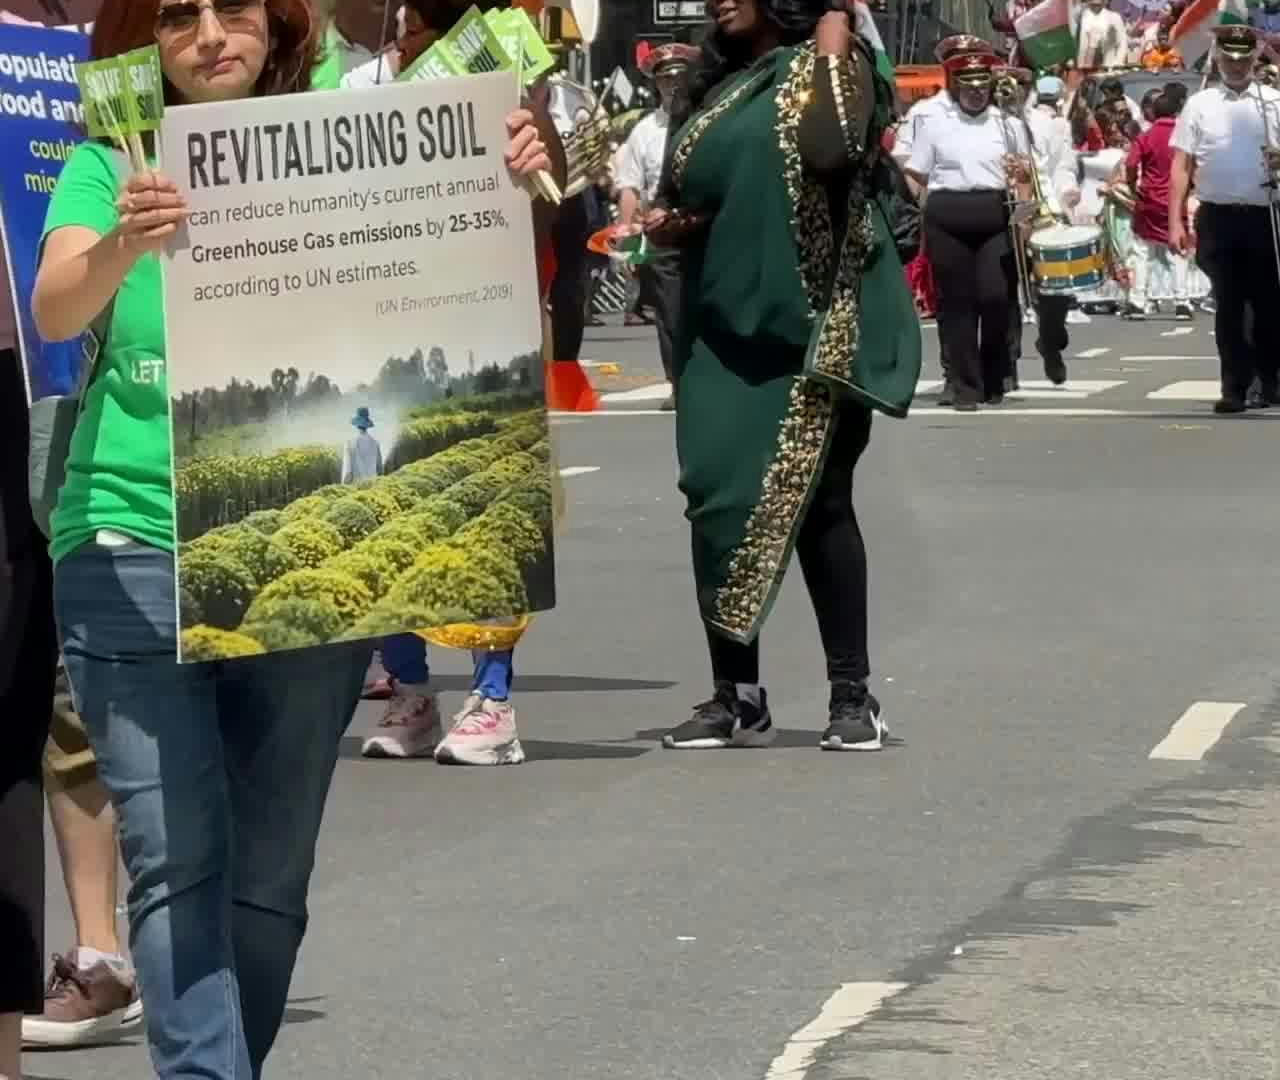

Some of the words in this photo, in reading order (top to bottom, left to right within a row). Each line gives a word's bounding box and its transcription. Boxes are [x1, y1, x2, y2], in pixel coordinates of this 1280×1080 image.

[187, 109, 408, 189] REVITALISING
[416, 101, 487, 163] SOIL
[190, 206, 220, 228] can
[225, 194, 285, 223] reduce
[288, 187, 381, 217] humanity's
[383, 180, 443, 206] current
[446, 171, 501, 197] annual
[191, 236, 298, 264] Greenhouse
[303, 231, 335, 251] Gas
[339, 222, 422, 248] emissions
[425, 213, 446, 238] by
[192, 268, 281, 302] according
[284, 270, 301, 291] to
[305, 264, 332, 288] UN
[335, 258, 421, 286] estimates.
